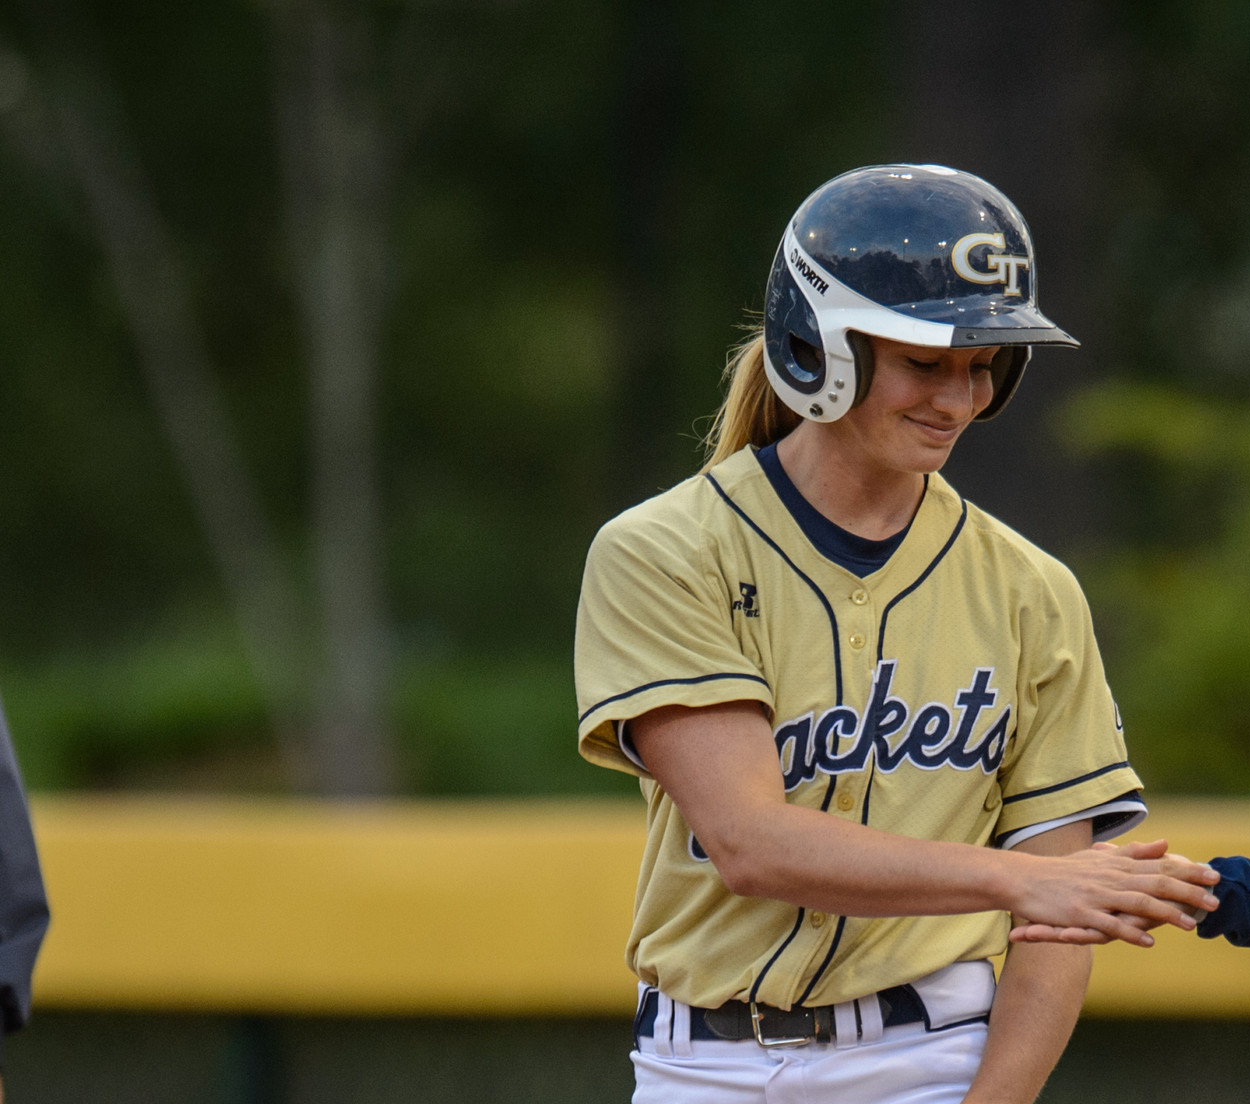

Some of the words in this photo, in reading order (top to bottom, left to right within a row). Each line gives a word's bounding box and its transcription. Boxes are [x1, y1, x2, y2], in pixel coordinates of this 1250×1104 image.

[795, 255, 829, 296] WORTH
[951, 232, 1030, 297] GT
[773, 658, 1012, 793] ackets
